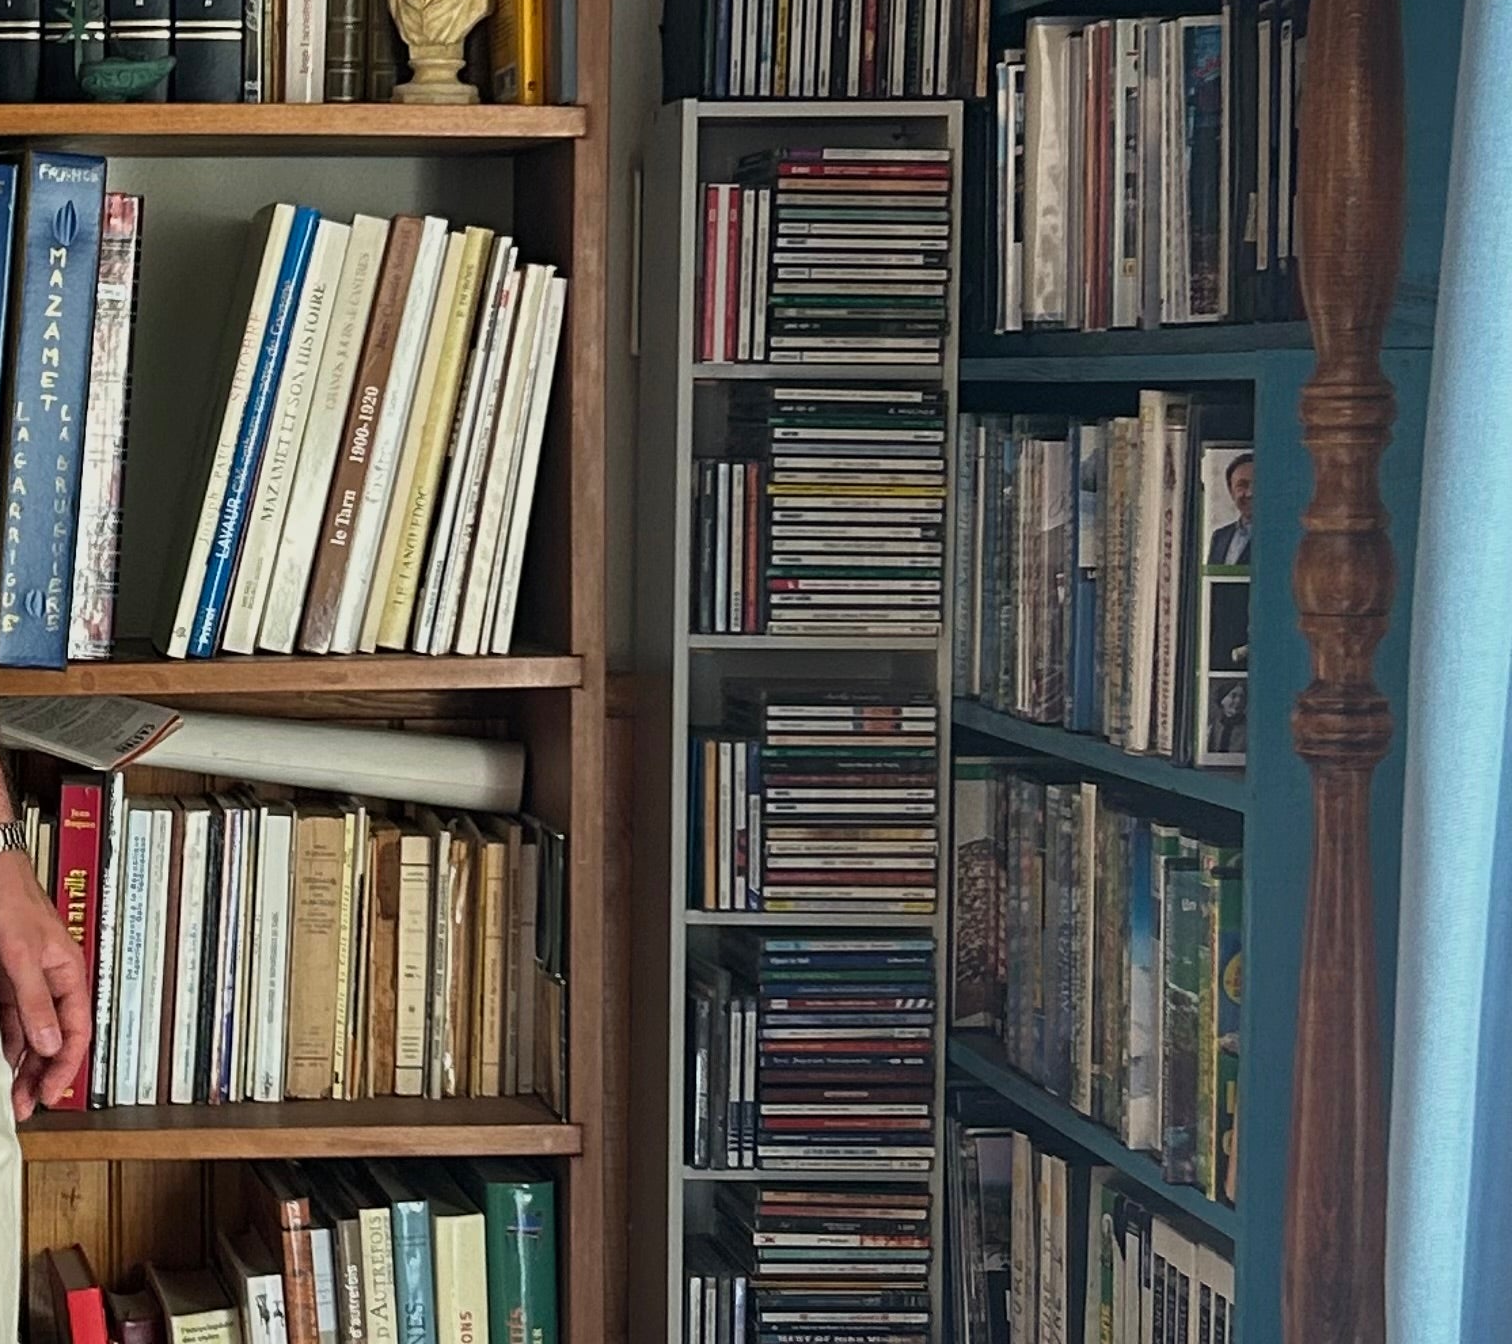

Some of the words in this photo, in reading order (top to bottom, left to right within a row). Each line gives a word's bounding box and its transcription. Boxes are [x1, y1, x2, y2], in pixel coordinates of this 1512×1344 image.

[40, 247, 68, 412] MAZAMET
[295, 282, 326, 367] HISTOIRE
[281, 411, 295, 432] ET
[287, 372, 304, 410] SON
[348, 386, 380, 463] 1900-1920
[260, 439, 289, 522] MAZAMET
[335, 489, 357, 526] Tarn
[215, 497, 239, 559] LAVAUR
[330, 529, 348, 546] le
[343, 1263, 364, 1339] d'autrefois
[369, 1214, 393, 1338] D'AUTREFOIS
